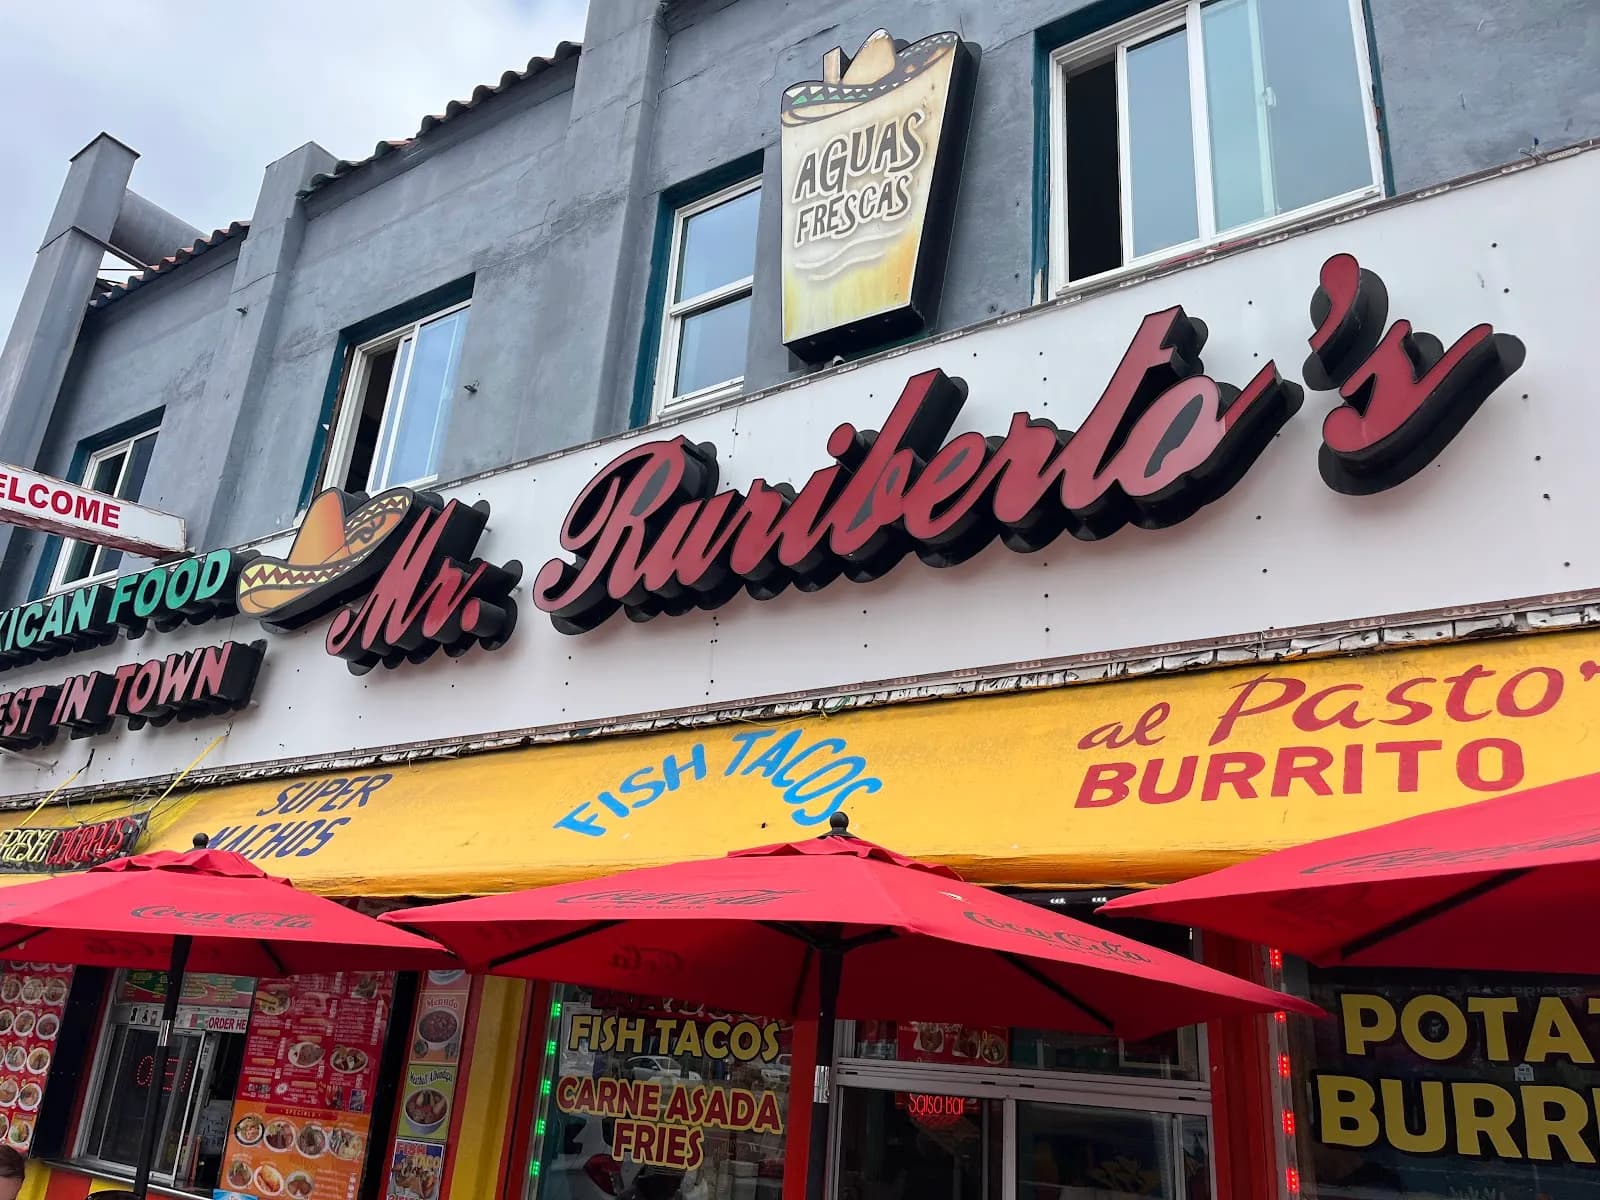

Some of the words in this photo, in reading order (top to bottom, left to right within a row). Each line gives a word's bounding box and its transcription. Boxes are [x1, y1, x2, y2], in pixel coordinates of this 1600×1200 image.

[794, 111, 922, 200] AGUAS
[796, 175, 910, 244] FRESCAS
[325, 498, 488, 656] Mr.
[533, 252, 1494, 613] Ruriberto's
[107, 548, 231, 623] FOOD
[50, 671, 99, 725] IN
[107, 641, 232, 716] TOWN
[1077, 701, 1170, 750] al
[1208, 659, 1600, 747] Pasto
[256, 773, 393, 816] SUPER
[553, 743, 706, 837] FISH
[724, 728, 883, 826] TACOS
[1074, 737, 1525, 809] BURRITO
[208, 1016, 235, 1031] ORDER
[568, 1014, 645, 1054] FISH
[655, 1018, 782, 1063] TACOS
[1340, 993, 1600, 1064] POTA
[556, 1075, 662, 1120] CARNE
[664, 1084, 784, 1135] ASADA
[908, 1092, 943, 1116] Salsa
[945, 1096, 966, 1116] Bar
[612, 1118, 704, 1171] FRIES
